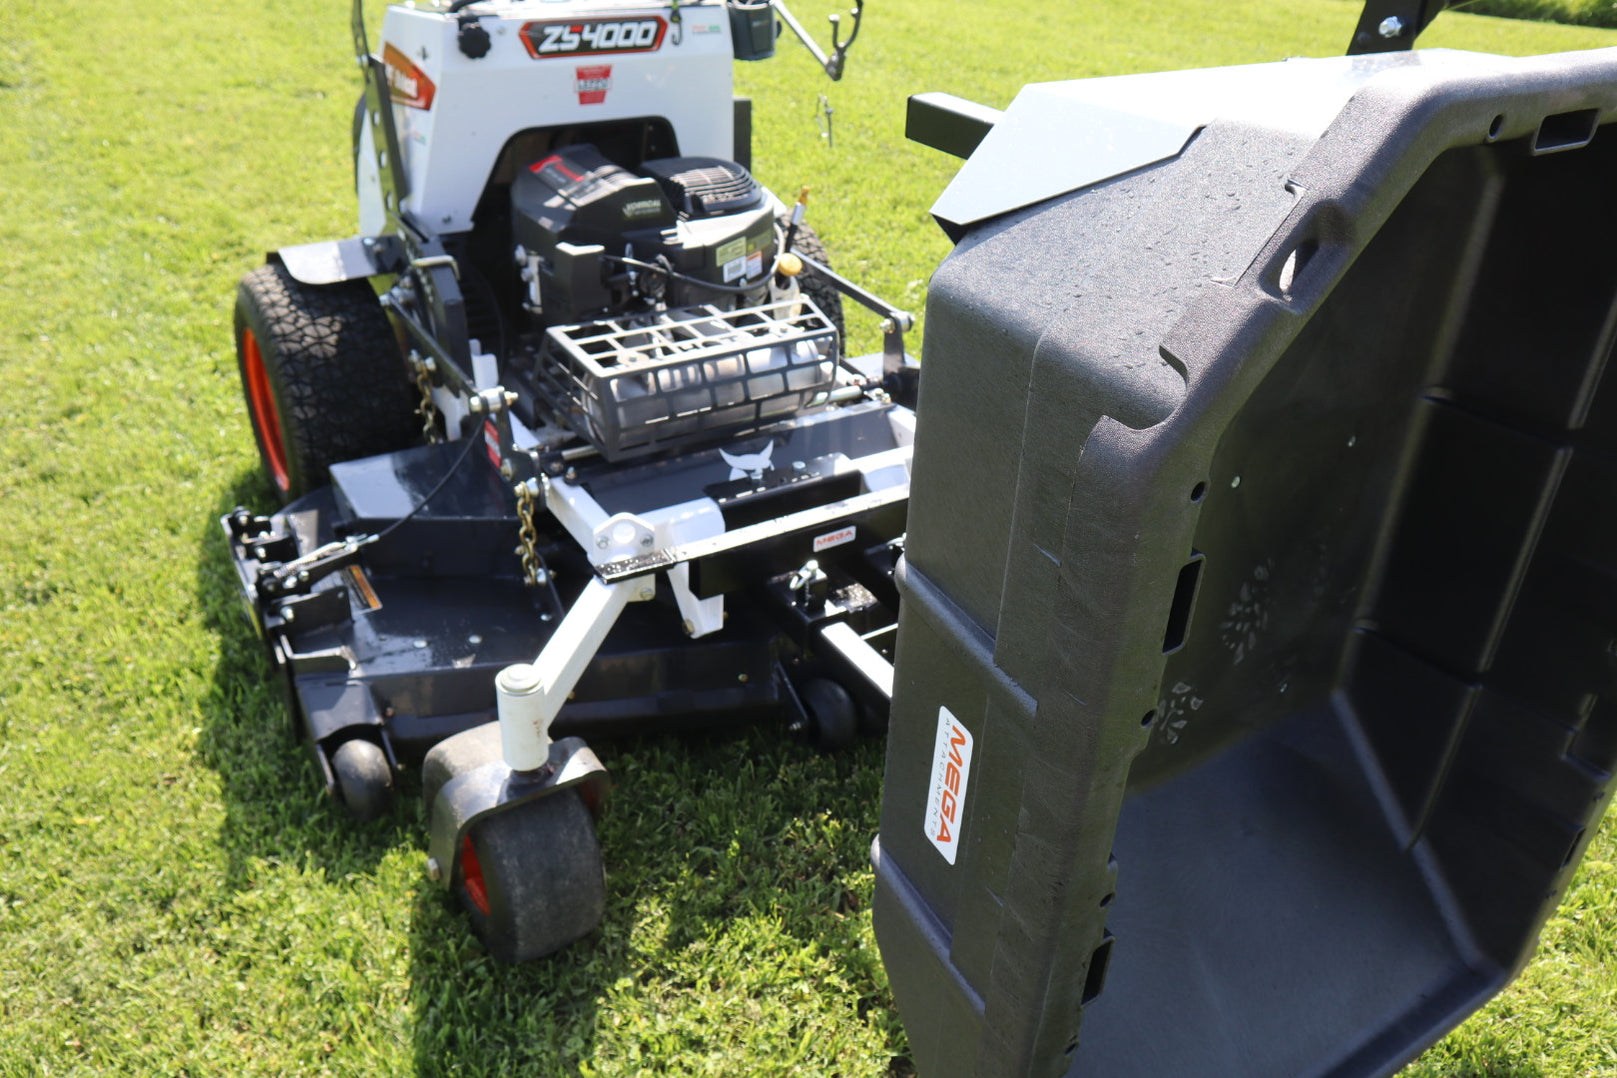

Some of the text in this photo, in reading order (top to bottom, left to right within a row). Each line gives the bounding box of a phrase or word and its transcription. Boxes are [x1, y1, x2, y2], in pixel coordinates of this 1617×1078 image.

[538, 21, 658, 53] ZS4000
[930, 717, 951, 837] ATTACHMENTS
[937, 725, 966, 843] MEGA
